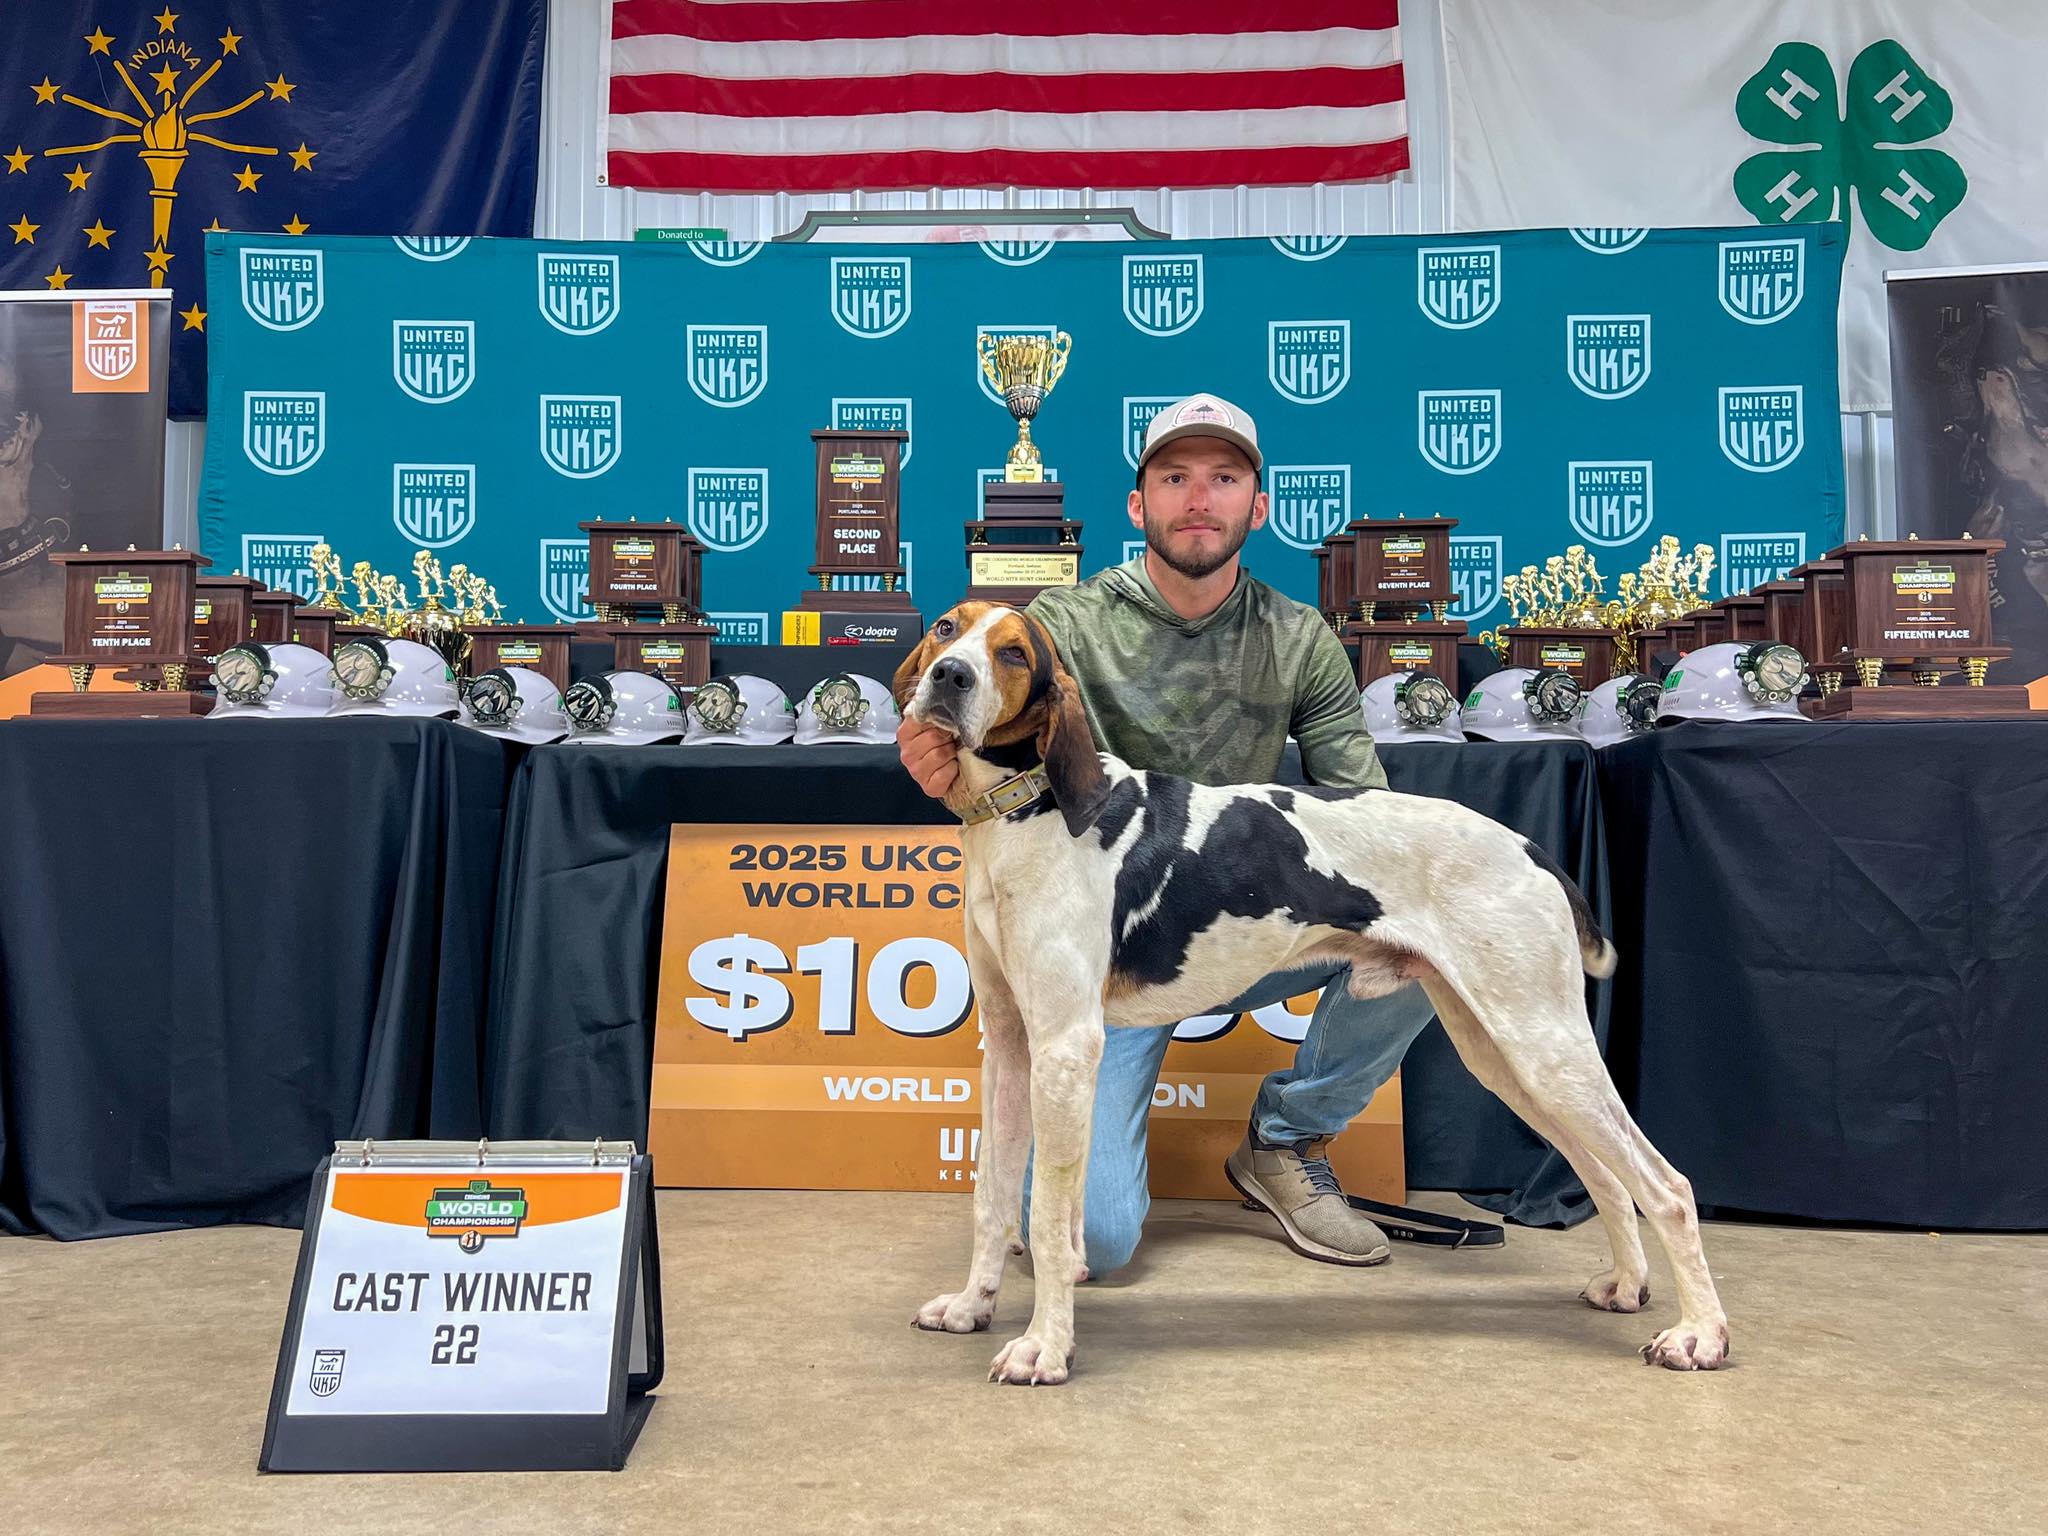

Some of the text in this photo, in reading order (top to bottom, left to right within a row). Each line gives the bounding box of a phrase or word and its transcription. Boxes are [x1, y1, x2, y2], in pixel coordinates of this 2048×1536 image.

[128, 38, 201, 71] INDIANA
[1765, 69, 1820, 120] H
[1873, 70, 1927, 123] H
[1763, 170, 1818, 221] H
[1880, 168, 1935, 220] H
[657, 230, 704, 239] Donated to
[251, 257, 312, 271] UNITED
[1429, 255, 1490, 269] UNITED
[1730, 249, 1794, 264] UNITED
[549, 263, 609, 276] UNITED
[841, 266, 901, 279] UNITED
[1133, 264, 1193, 277] UNITED
[252, 280, 313, 322] UKC
[1429, 278, 1490, 320] UKC
[1730, 272, 1793, 315] UKC
[549, 285, 609, 326] UKC
[842, 289, 901, 329] UKC
[1133, 287, 1193, 327] UKC
[404, 330, 464, 343] UNITED
[1279, 330, 1340, 343] UNITED
[1578, 324, 1640, 338] UNITED
[697, 334, 757, 347] UNITED
[91, 346, 130, 374] UKC
[404, 353, 464, 394] UKC
[1279, 354, 1340, 395] UKC
[1578, 348, 1640, 390] UKC
[698, 358, 757, 398] UKC
[255, 401, 315, 414] UNITED
[1429, 400, 1491, 413] UNITED
[1729, 396, 1792, 410] UNITED
[550, 404, 611, 418] UNITED
[842, 407, 902, 420] UNITED
[254, 425, 315, 466] UKC
[551, 428, 611, 469] UKC
[1429, 423, 1490, 465] UKC
[1730, 420, 1793, 463] UKC
[837, 464, 878, 472] WORLD
[404, 473, 465, 487] UNITED
[698, 477, 758, 491] UNITED
[1279, 475, 1340, 488] UNITED
[1579, 471, 1642, 484] UNITED
[404, 497, 465, 538] UKC
[699, 501, 758, 542] UKC
[1279, 499, 1340, 540] UKC
[1580, 495, 1642, 537] UKC
[833, 529, 881, 539] SECOND
[252, 544, 313, 558] UNITED
[551, 549, 590, 562] UNIT
[839, 544, 876, 553] PLACE
[1732, 542, 1795, 557] UNITED
[1901, 573, 1947, 582] WORLD
[102, 583, 145, 593] WORLD
[864, 625, 898, 637] dogtra
[1884, 630, 1970, 639] FIFTEENTH PLACE
[92, 637, 151, 647] TENTH PLACE
[729, 844, 962, 872] 2025 UKC
[742, 882, 914, 908] WORLD
[823, 1077, 971, 1102] WORLD
[439, 1202, 515, 1215] WORLD
[432, 1218, 516, 1227] CHAMPIONSHIP
[333, 1272, 592, 1312] CAST WINNER
[431, 1324, 480, 1365] 22
[314, 1377, 337, 1393] UKC
